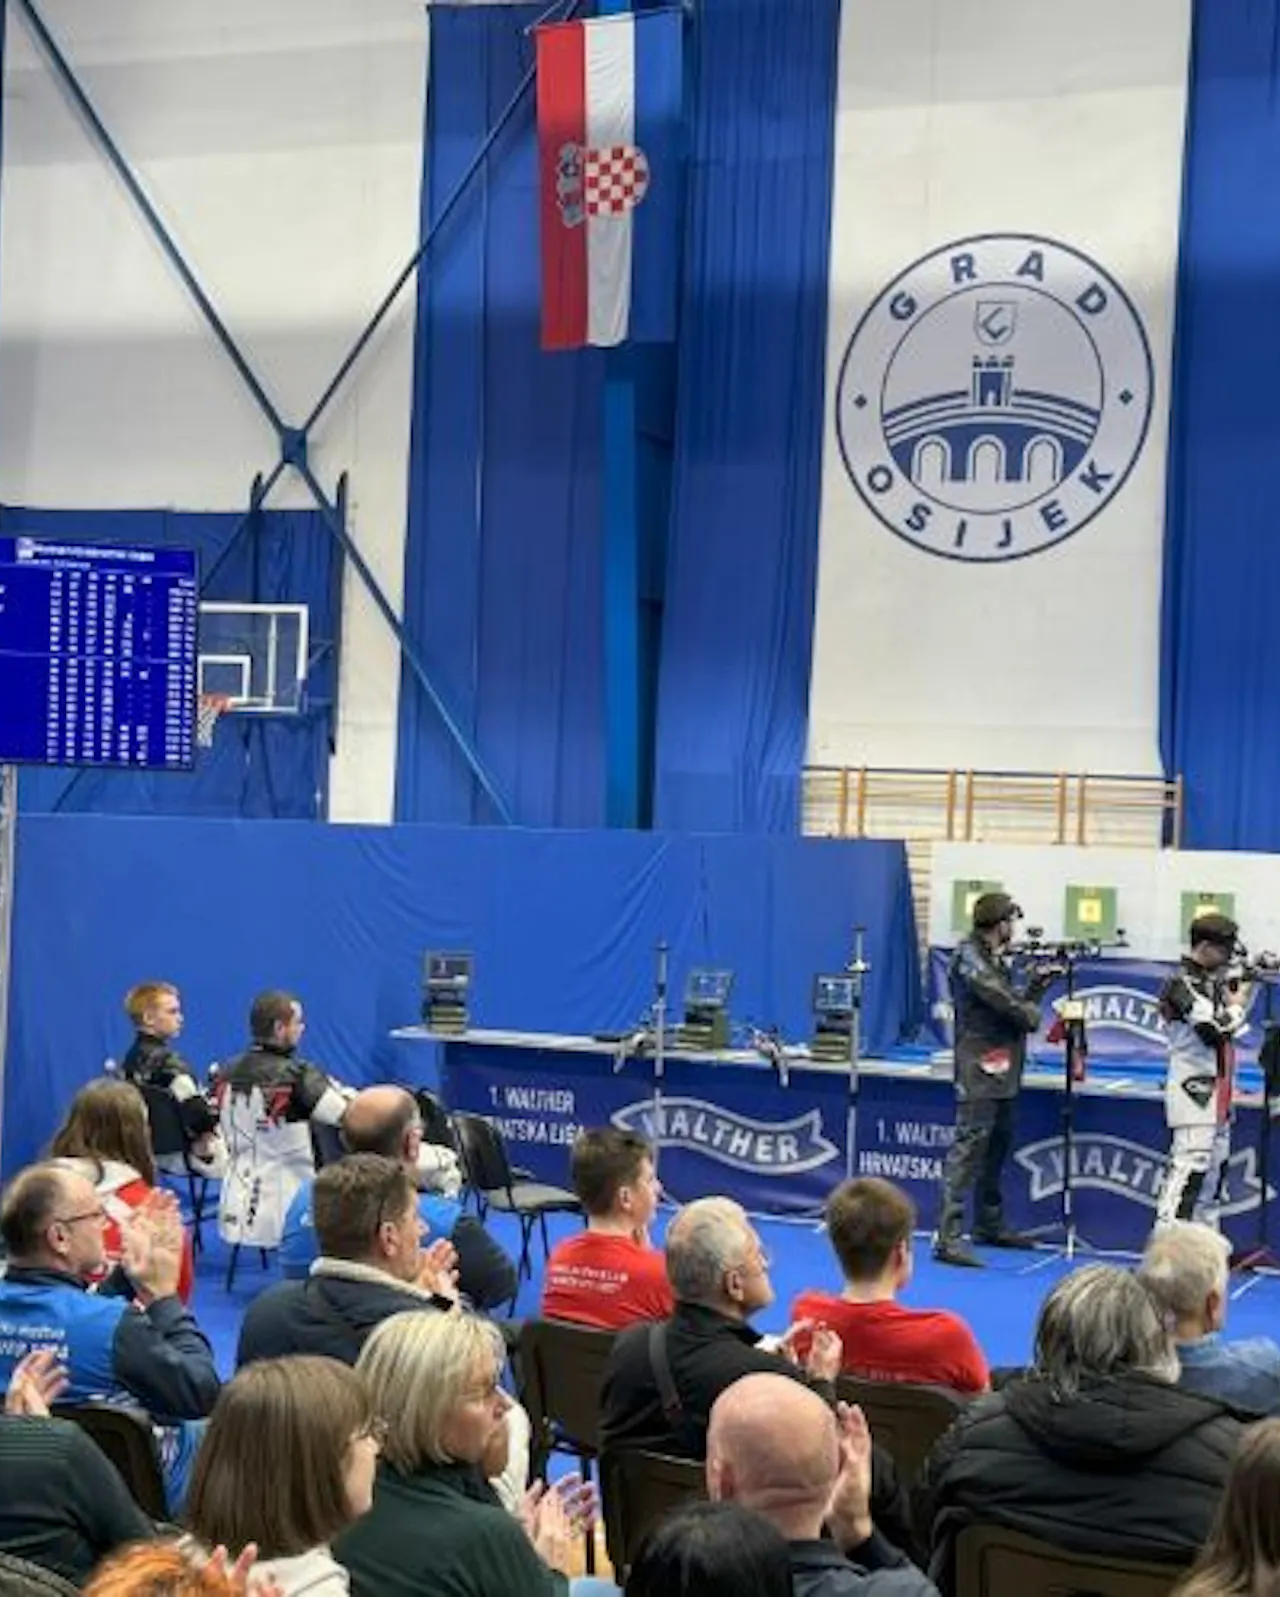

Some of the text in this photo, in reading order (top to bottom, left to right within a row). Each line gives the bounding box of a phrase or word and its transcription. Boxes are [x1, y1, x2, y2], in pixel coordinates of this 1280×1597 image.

[889, 249, 1108, 323] GRAD
[866, 458, 1114, 548] OSIJEK
[504, 1086, 576, 1115] WALTHER
[859, 1149, 944, 1180] HRVATSKA
